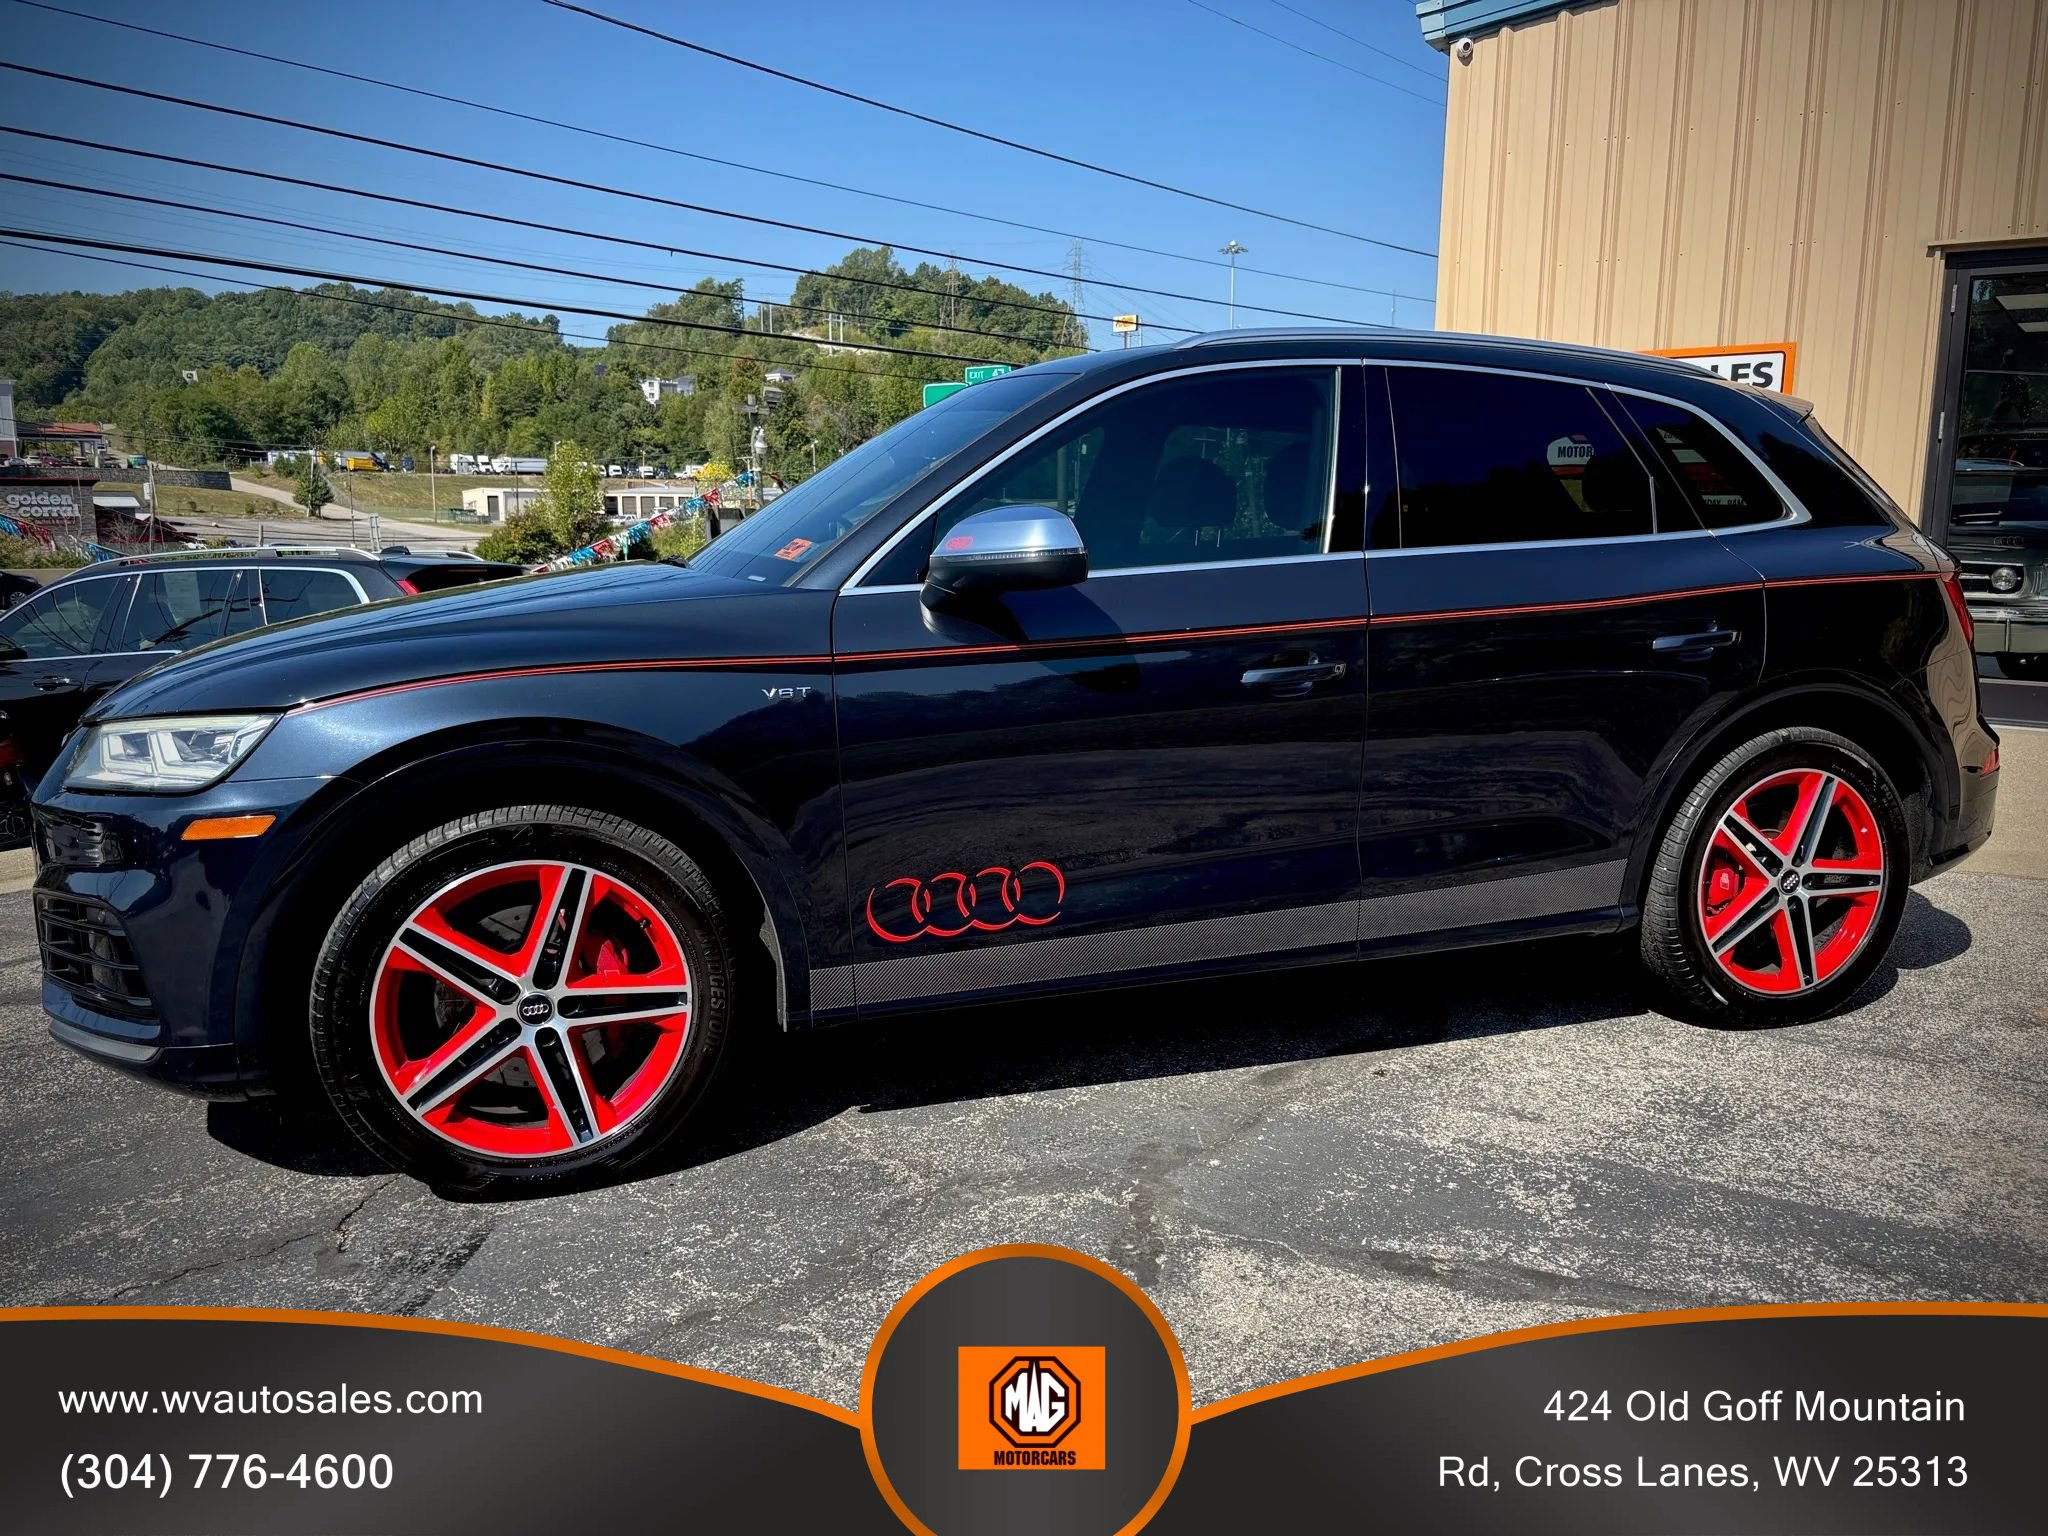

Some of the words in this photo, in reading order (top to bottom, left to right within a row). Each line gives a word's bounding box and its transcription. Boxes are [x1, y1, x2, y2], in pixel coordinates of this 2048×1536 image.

[969, 370, 984, 380] EXIT
[6, 491, 73, 509] golden
[17, 503, 80, 518] corral
[761, 686, 812, 699] V6T
